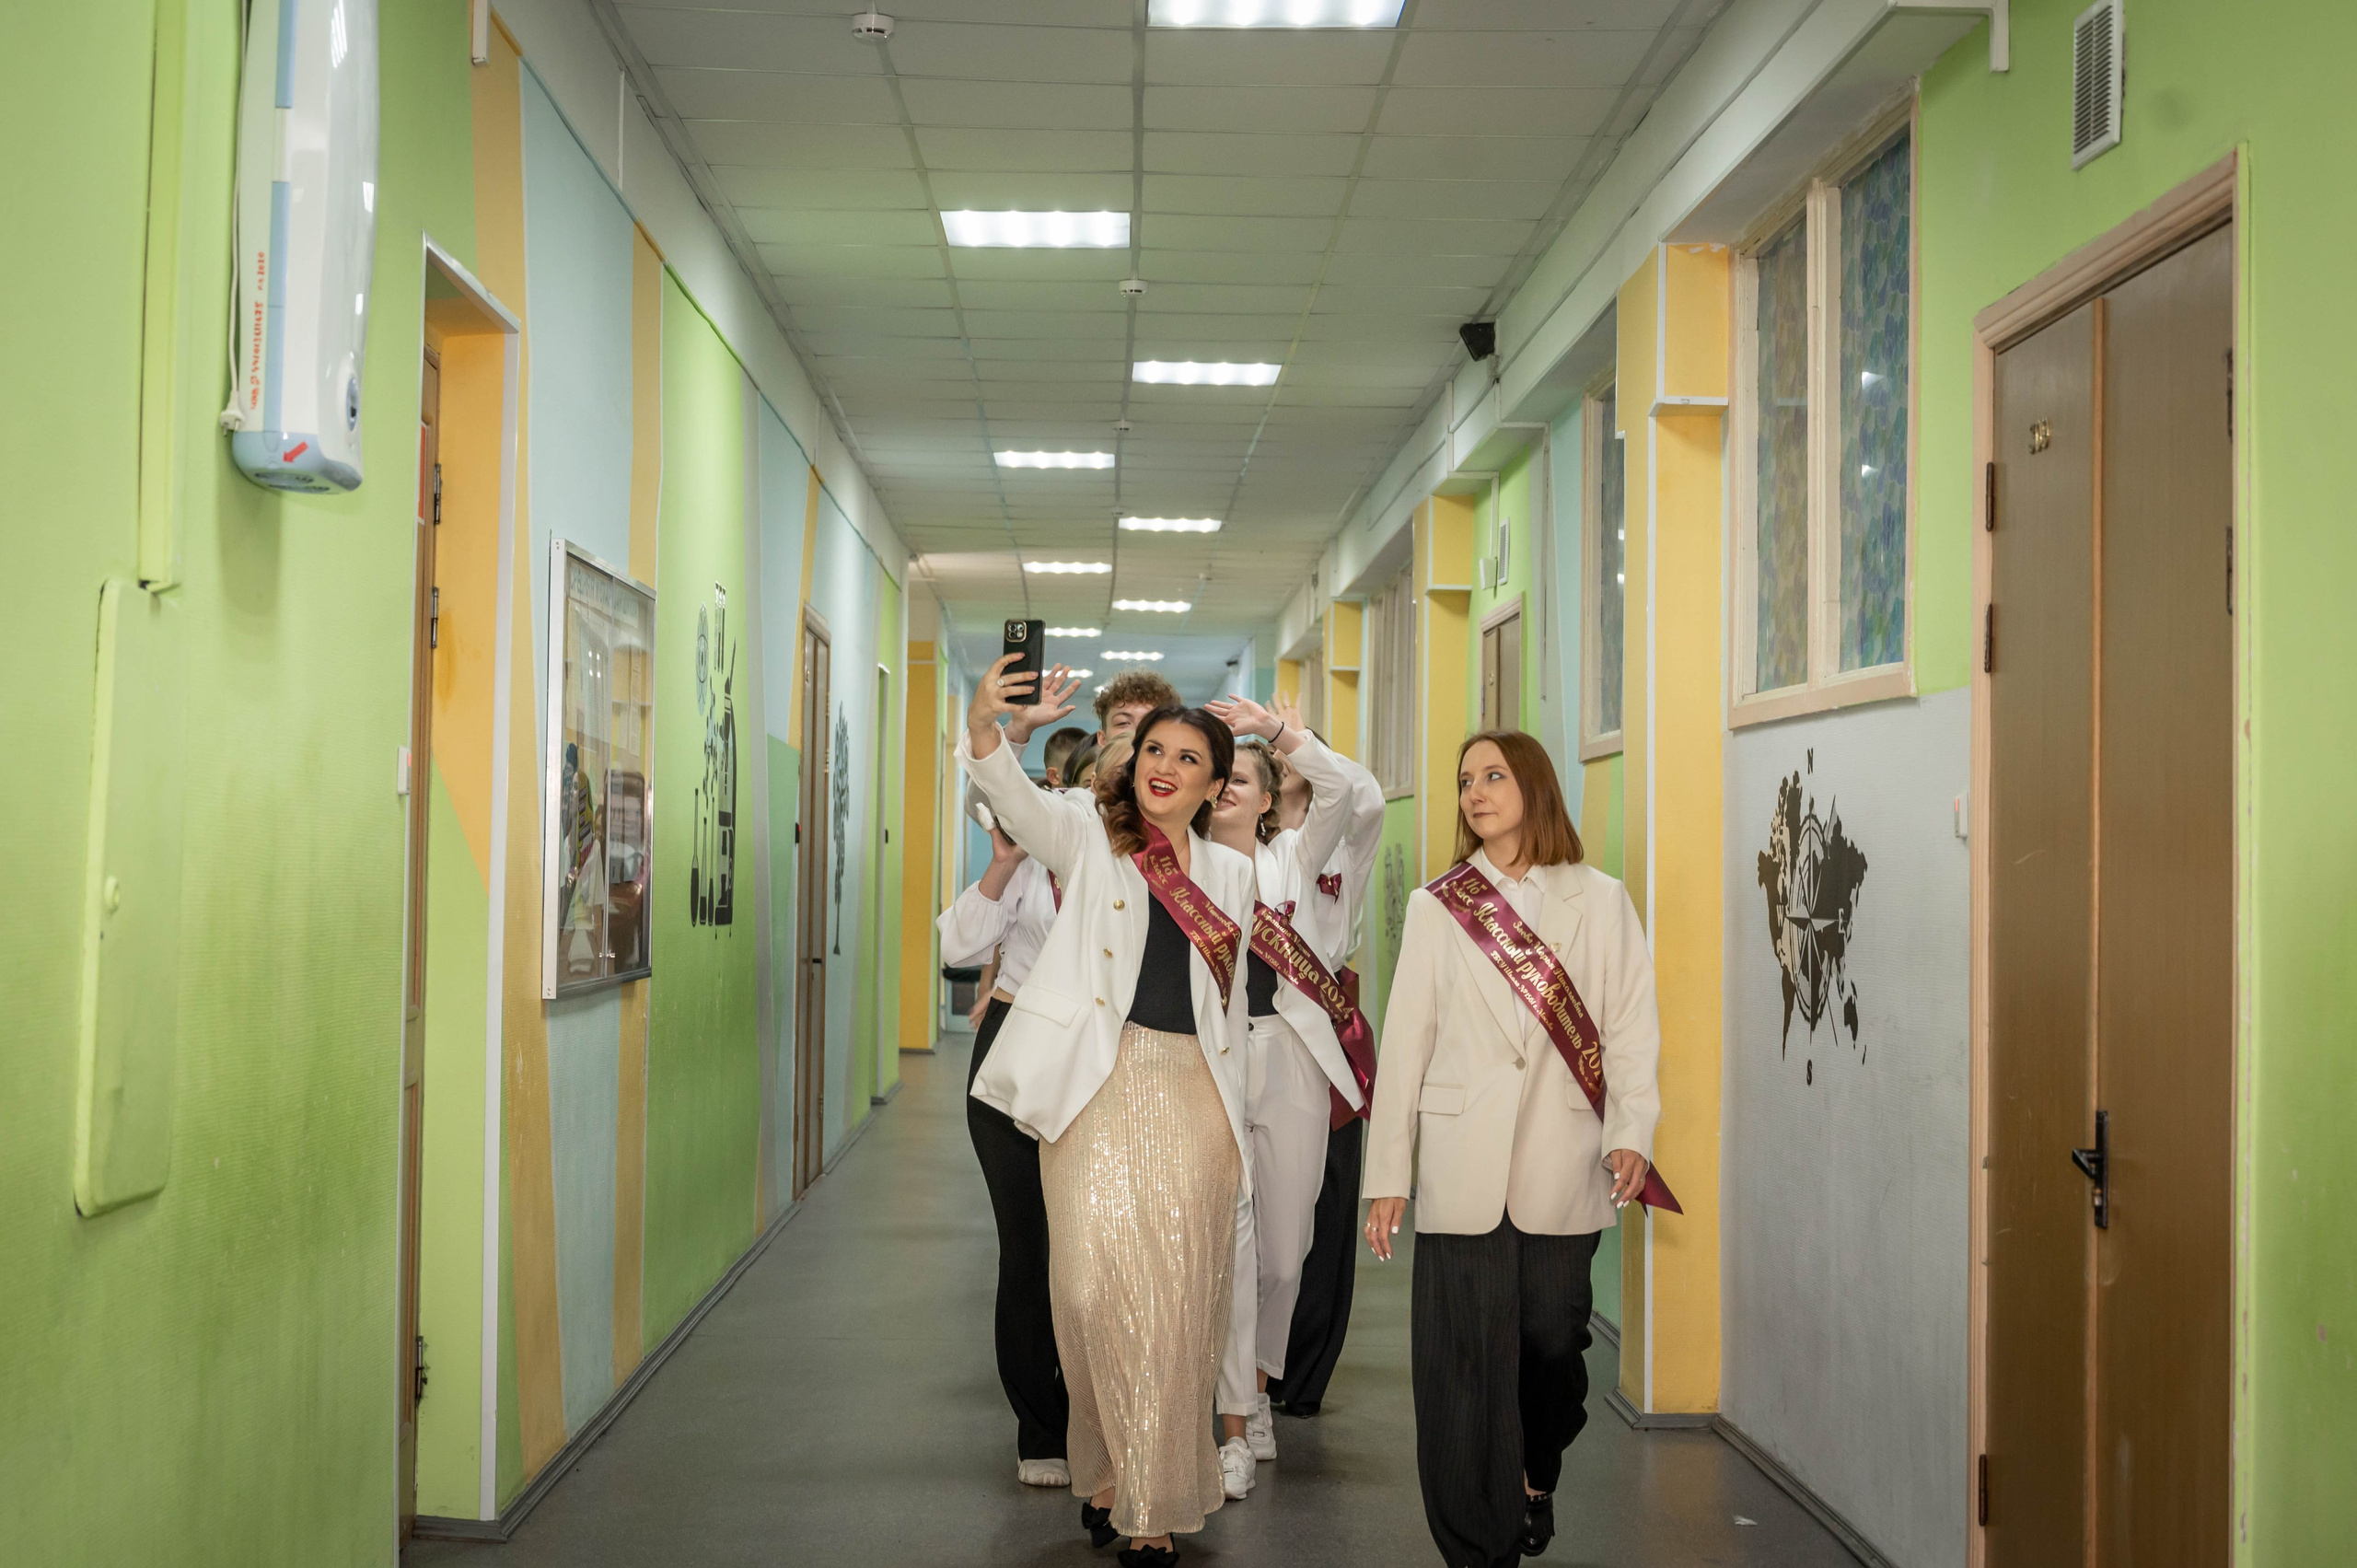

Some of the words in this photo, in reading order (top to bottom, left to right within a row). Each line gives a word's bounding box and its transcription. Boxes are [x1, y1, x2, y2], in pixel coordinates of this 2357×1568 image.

[1806, 748, 1814, 774] N
[1169, 887, 1227, 946] Классный
[1776, 904, 1785, 928] W
[1838, 908, 1847, 934] E
[1473, 902, 1533, 964] Классный
[1515, 961, 1583, 1050] руководитель
[1552, 968, 1584, 1018] Николаевна
[1319, 975, 1354, 1020] 2024
[1806, 1059, 1814, 1086] S
